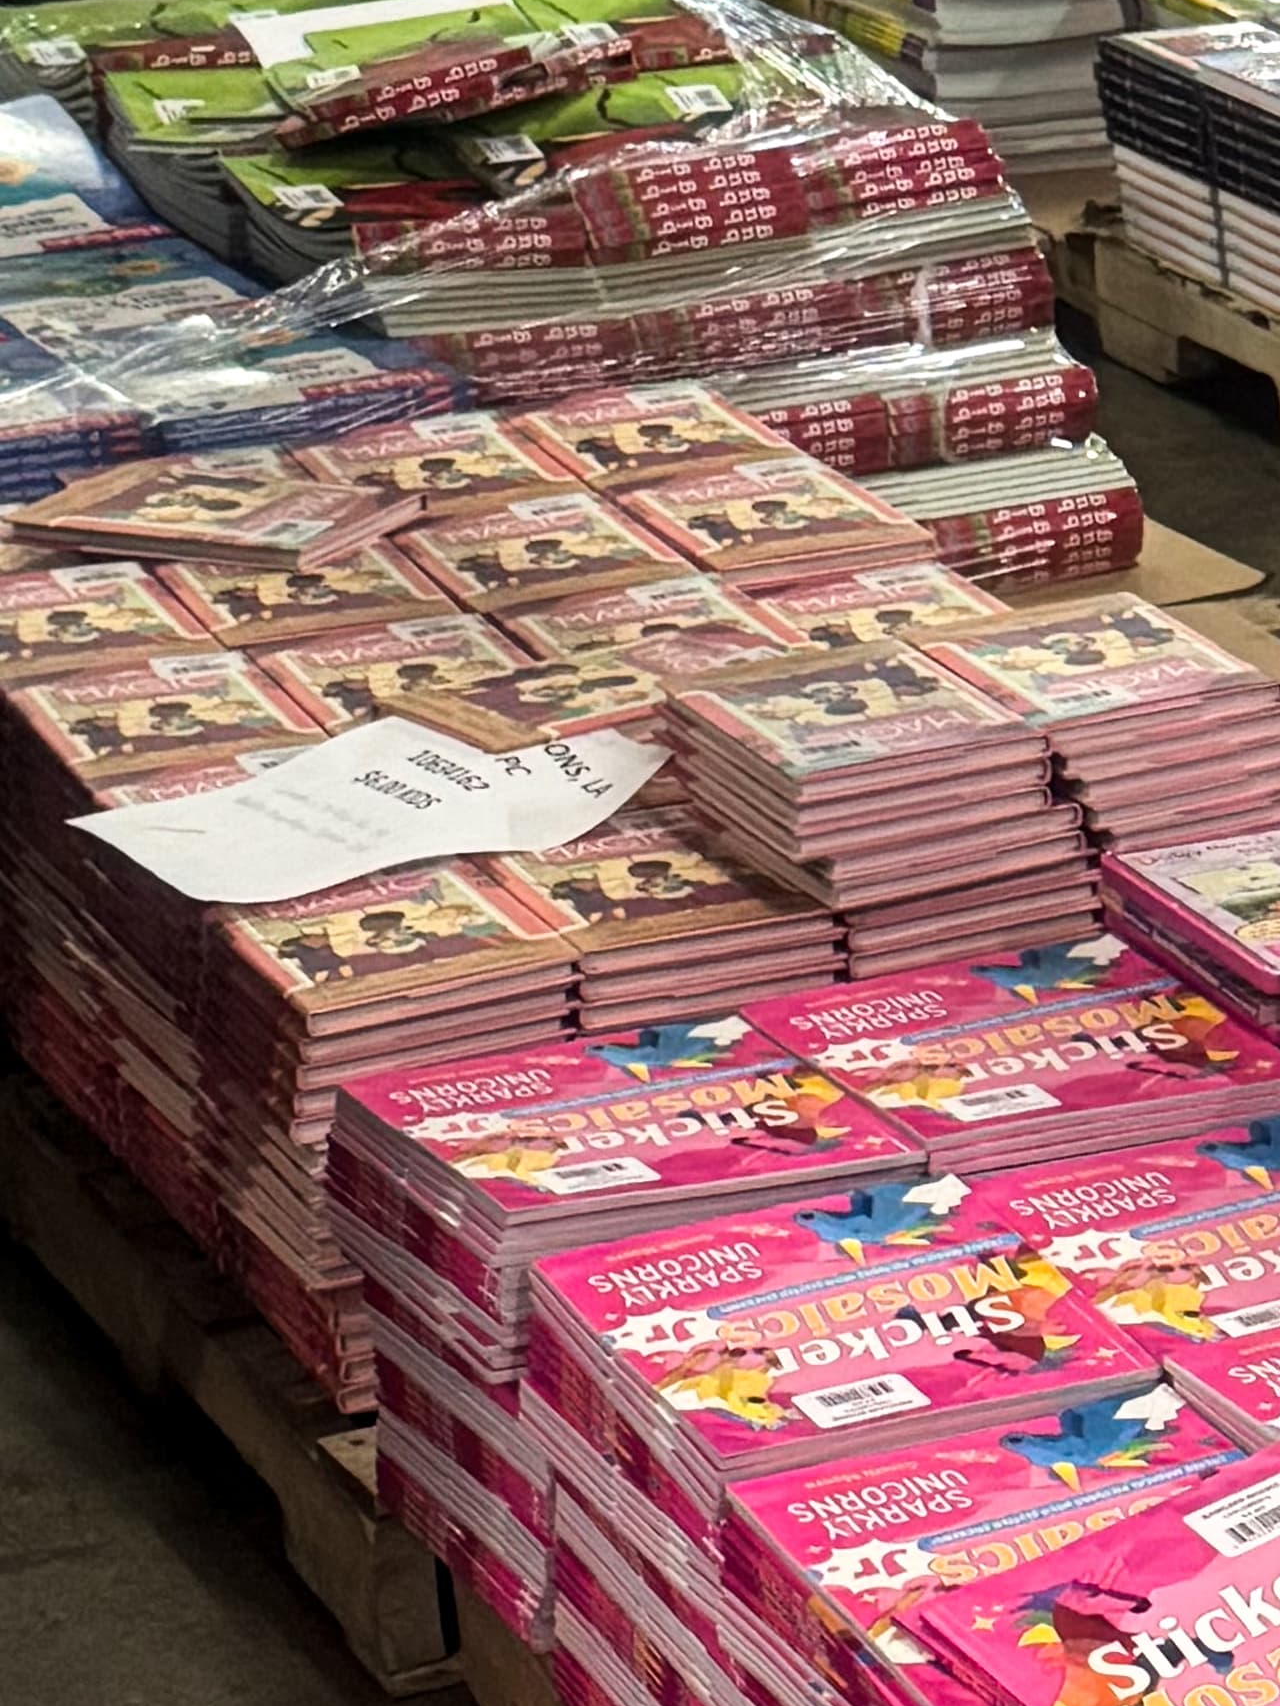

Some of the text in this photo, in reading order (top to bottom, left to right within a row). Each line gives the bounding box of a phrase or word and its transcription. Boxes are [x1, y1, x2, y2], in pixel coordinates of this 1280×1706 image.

[494, 756, 532, 776] PC
[581, 778, 614, 798] LA
[789, 990, 943, 1030] UNICORNS
[819, 1002, 948, 1040] SPARKLY
[916, 994, 1184, 1065] Mosaics
[961, 1022, 1189, 1084] Sticker
[389, 1069, 551, 1104] UNICORNS
[417, 1080, 553, 1114] SPARKLY
[510, 1074, 799, 1136] Mosaics
[553, 1100, 799, 1156] Sticker
[1008, 1171, 1172, 1217] UNICORNS
[1044, 1189, 1177, 1230] SPARKLY
[587, 1242, 761, 1294] UNICORNS
[1062, 1238, 1123, 1263] Jr
[620, 1260, 763, 1309] SPARKLY
[643, 1254, 1024, 1346] Mosaics Jr
[771, 1295, 1025, 1376] Sticker
[787, 1469, 969, 1524] UNICORNS
[821, 1489, 974, 1541] SPARKLY
[851, 1548, 909, 1581] Jr
